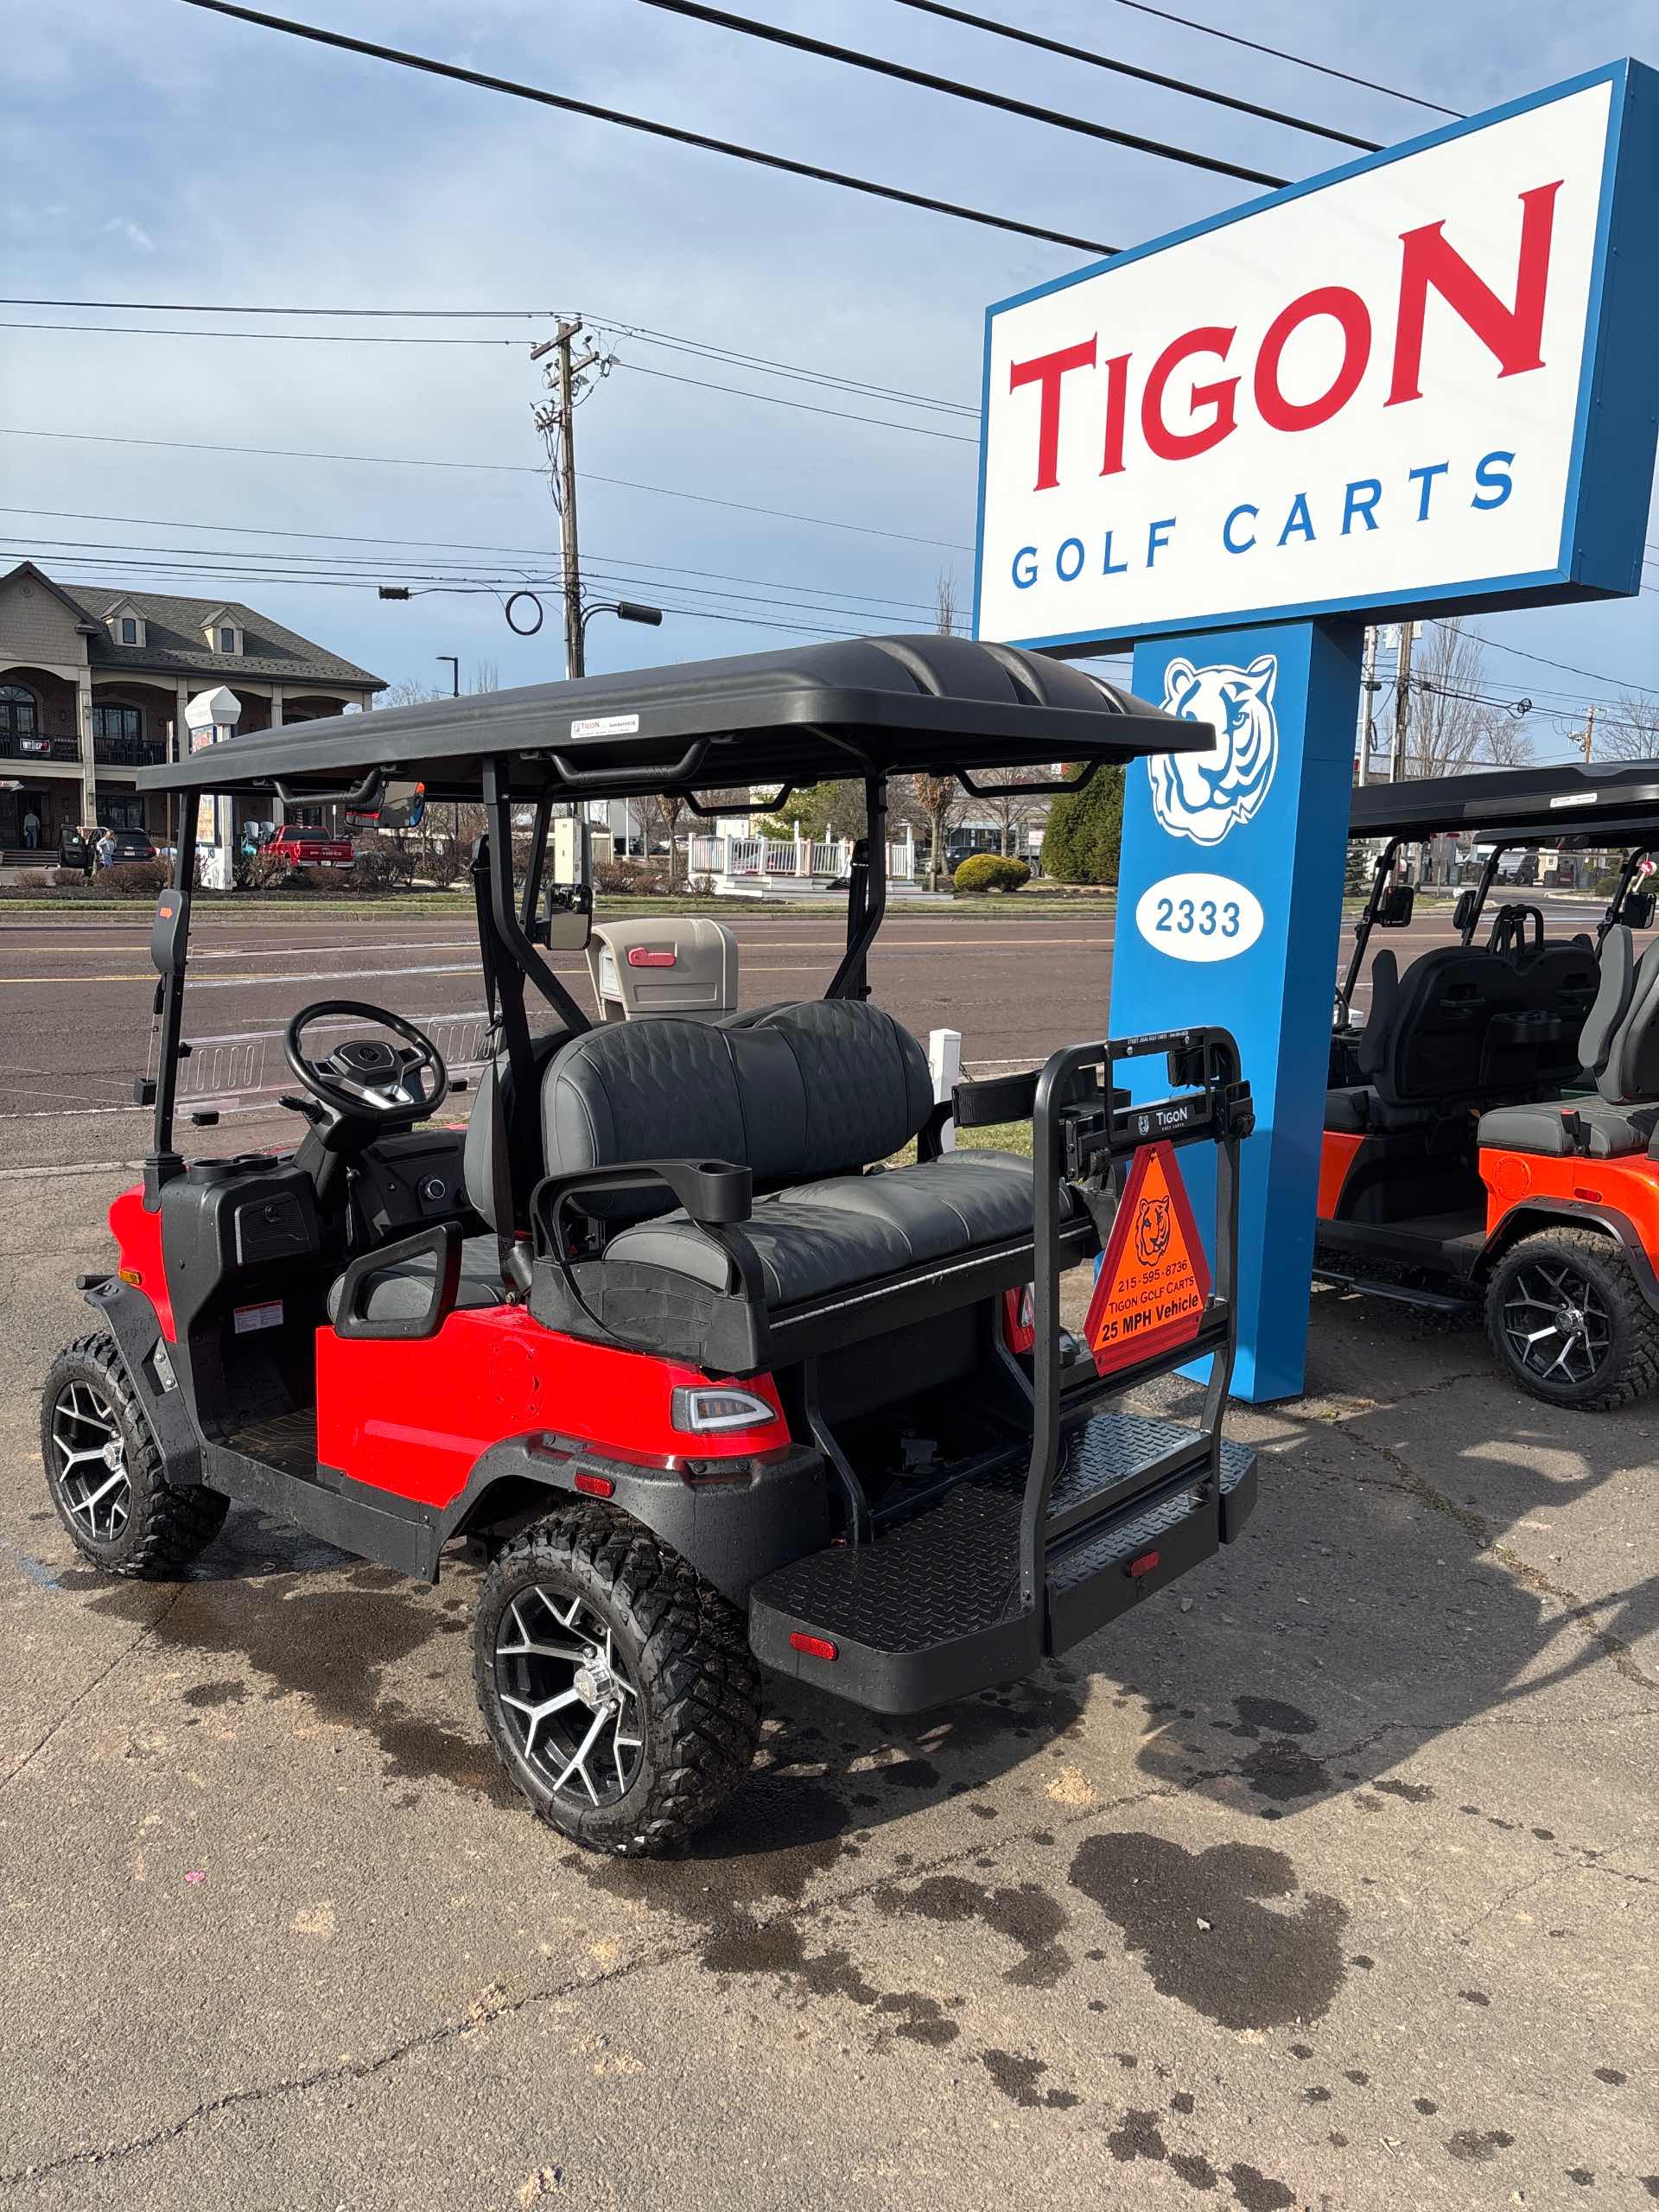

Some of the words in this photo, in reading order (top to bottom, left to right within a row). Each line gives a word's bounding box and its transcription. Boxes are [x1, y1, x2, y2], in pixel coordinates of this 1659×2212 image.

[1009, 179, 1565, 493] TIGON
[1011, 517, 1177, 591] GOLF
[1222, 450, 1517, 555] CARTS
[1154, 897, 1241, 938] 2333
[1155, 1106, 1188, 1126] TIGON
[1102, 1320, 1119, 1342] 25
[1122, 1308, 1152, 1335] MPH
[1155, 1293, 1198, 1322] Vehicle
[1109, 1296, 1138, 1314] TIGON
[1140, 1287, 1165, 1304] GOLF
[1166, 1276, 1194, 1294] CARTS
